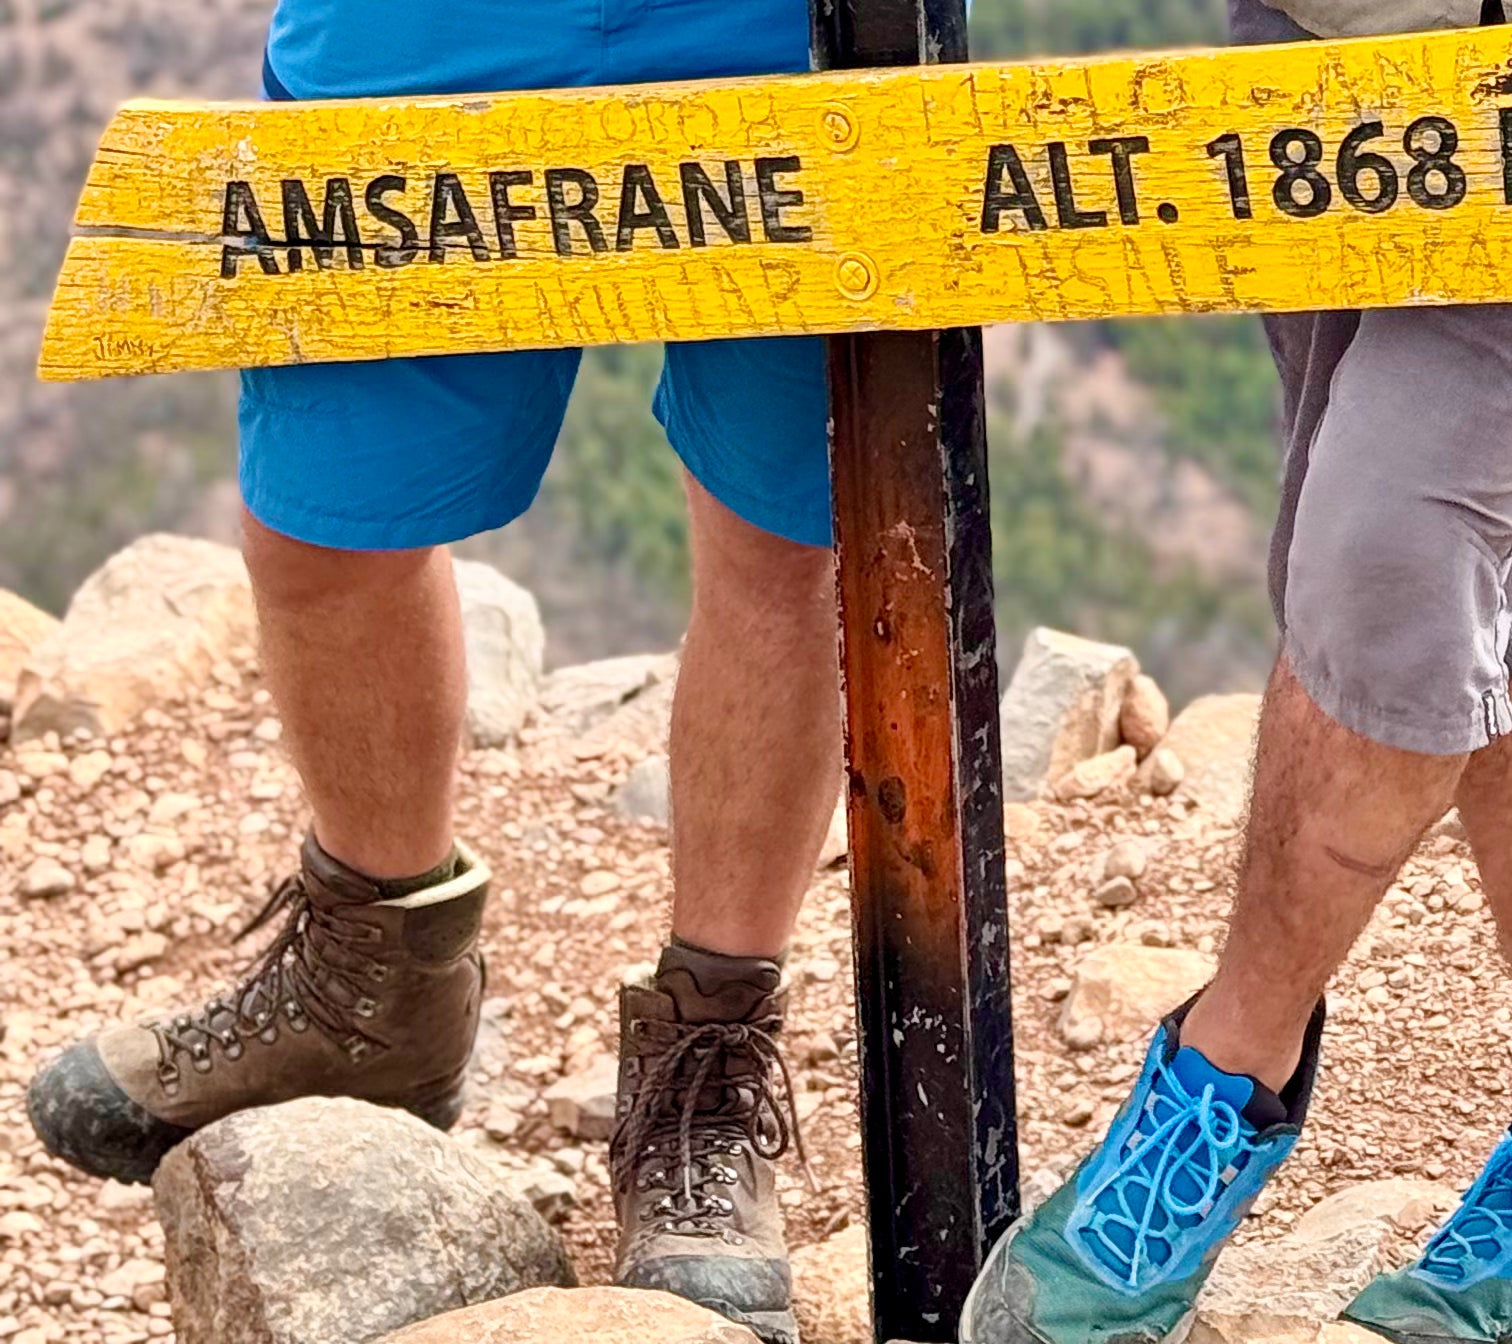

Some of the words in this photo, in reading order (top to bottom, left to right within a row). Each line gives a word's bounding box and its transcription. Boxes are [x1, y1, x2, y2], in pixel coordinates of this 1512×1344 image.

[219, 156, 812, 278] AMSAFRANE
[980, 136, 1180, 234] ALT.
[1207, 116, 1468, 220] 1868
